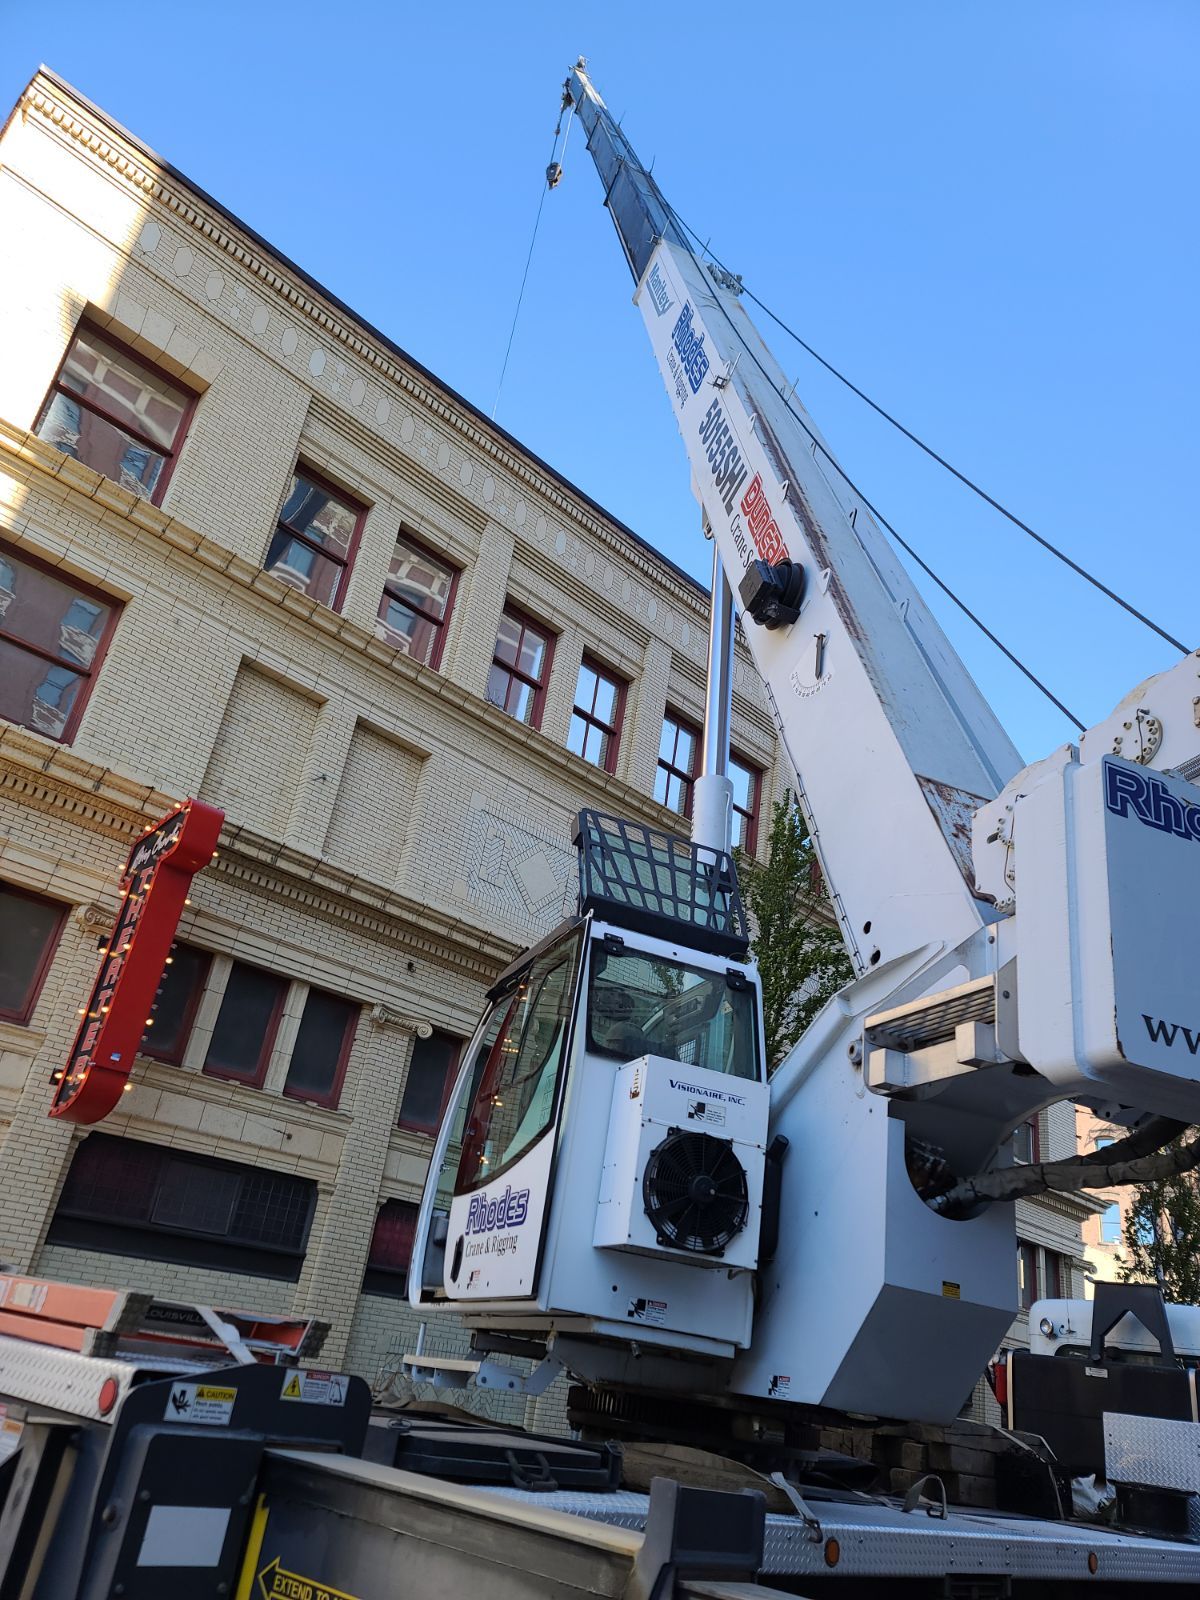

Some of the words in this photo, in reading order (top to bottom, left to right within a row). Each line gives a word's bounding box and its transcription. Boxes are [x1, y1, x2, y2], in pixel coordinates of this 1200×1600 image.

[671, 299, 710, 394] Rhodes
[730, 514, 748, 558] Crane
[465, 1185, 530, 1236] Rhodes
[465, 1241, 484, 1258] Crane
[484, 1237, 490, 1254] &
[491, 1232, 518, 1257] Rigging
[206, 1390, 235, 1400] CAUTION
[272, 1574, 313, 1600] EXTEND
